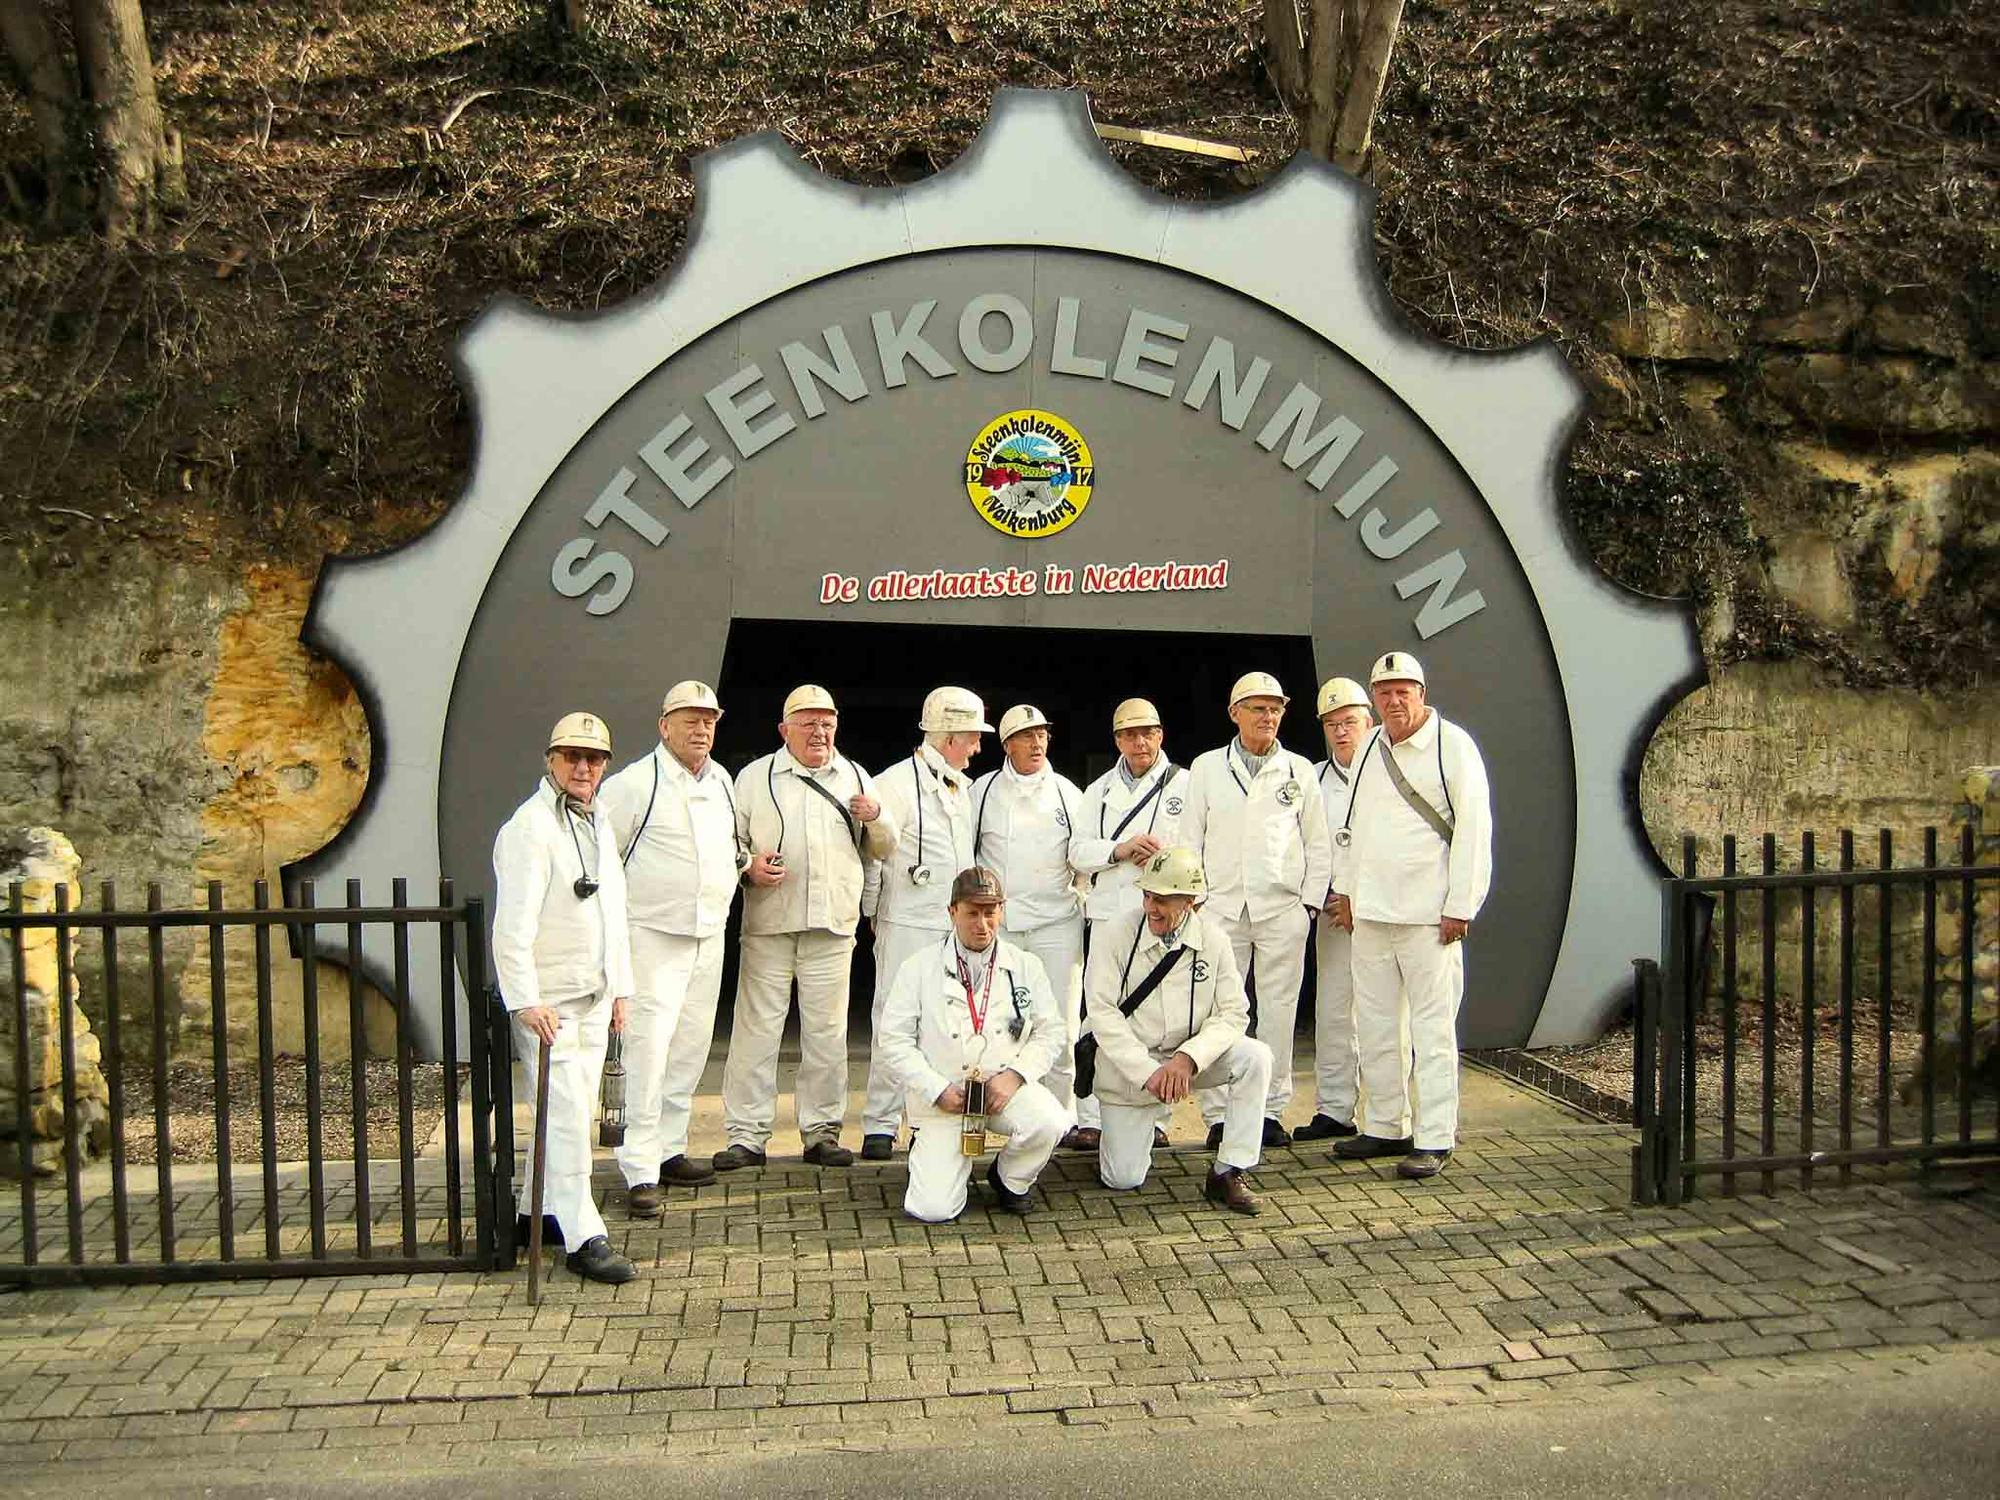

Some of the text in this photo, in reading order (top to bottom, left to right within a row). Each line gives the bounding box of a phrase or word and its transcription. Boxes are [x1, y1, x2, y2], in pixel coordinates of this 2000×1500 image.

[972, 415, 1081, 464] Steenkolenmijn
[551, 293, 1486, 640] STEENKOLENMIJN
[967, 464, 1093, 486] 19 17
[982, 495, 1077, 533] Valkenburg
[821, 560, 1228, 602] De allerlaatste in Nederland
